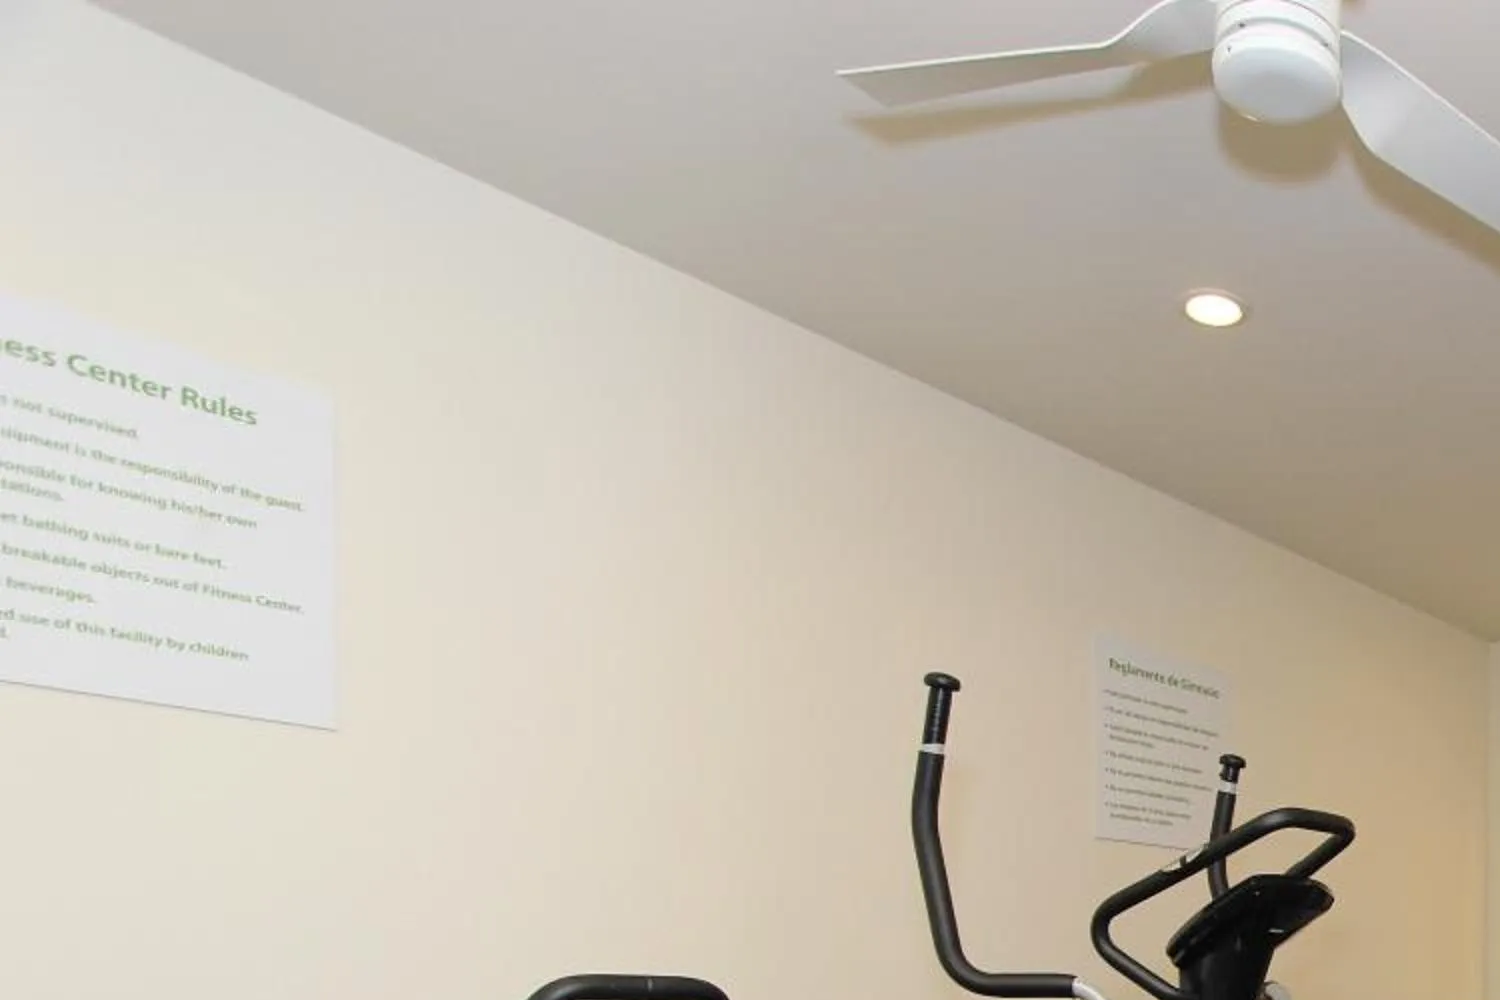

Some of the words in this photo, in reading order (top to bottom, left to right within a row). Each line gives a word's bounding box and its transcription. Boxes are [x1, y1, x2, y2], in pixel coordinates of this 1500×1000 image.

[0, 336, 57, 367] ess
[67, 353, 172, 399] Center
[181, 386, 258, 425] Rules
[70, 473, 94, 489] for
[98, 482, 167, 510] knowing
[171, 498, 222, 521] his/her
[225, 514, 258, 530] own
[91, 449, 117, 465] the
[121, 459, 219, 494] responsibility
[222, 483, 237, 495] of
[240, 486, 262, 503] the
[23, 514, 88, 541] bathing
[93, 532, 131, 548] suits
[134, 541, 152, 552] or
[155, 543, 190, 561] bare
[2, 543, 87, 571] breakable
[90, 562, 150, 583] objects
[152, 576, 180, 590] out
[182, 581, 198, 593] of
[203, 584, 252, 604] Fitness
[19, 613, 50, 626] use
[53, 618, 72, 630] of
[75, 621, 106, 636] this
[110, 627, 163, 648] facility
[166, 637, 185, 651] by
[189, 641, 250, 661] children
